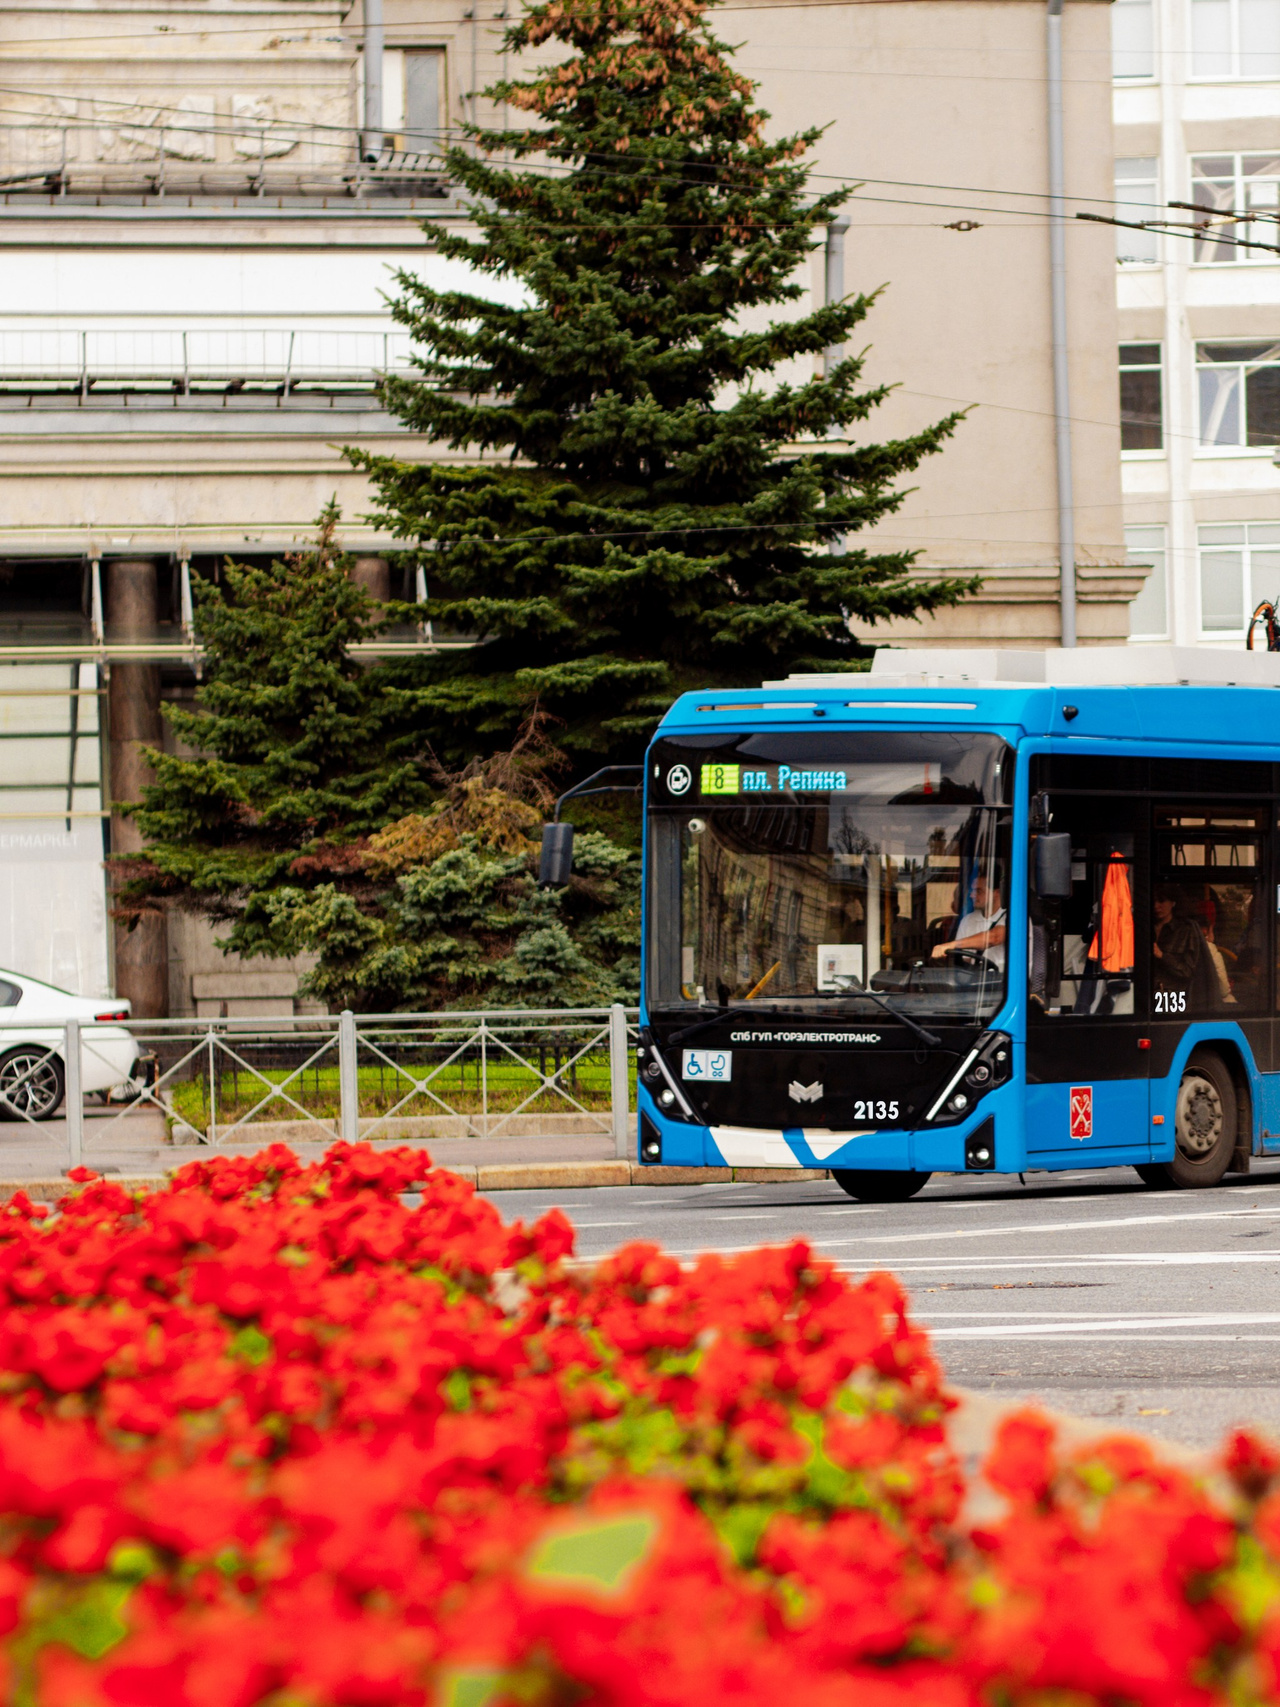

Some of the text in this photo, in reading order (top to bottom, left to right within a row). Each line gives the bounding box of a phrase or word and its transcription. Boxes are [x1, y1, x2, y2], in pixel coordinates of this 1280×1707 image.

[714, 765, 847, 791] 8 пл. Репина
[1154, 991, 1186, 1013] 2135
[751, 1031, 773, 1041] ГУП
[773, 1031, 882, 1043] «ГОРЭЛЕКТРОТРАНС»
[853, 1100, 900, 1120] 2135
